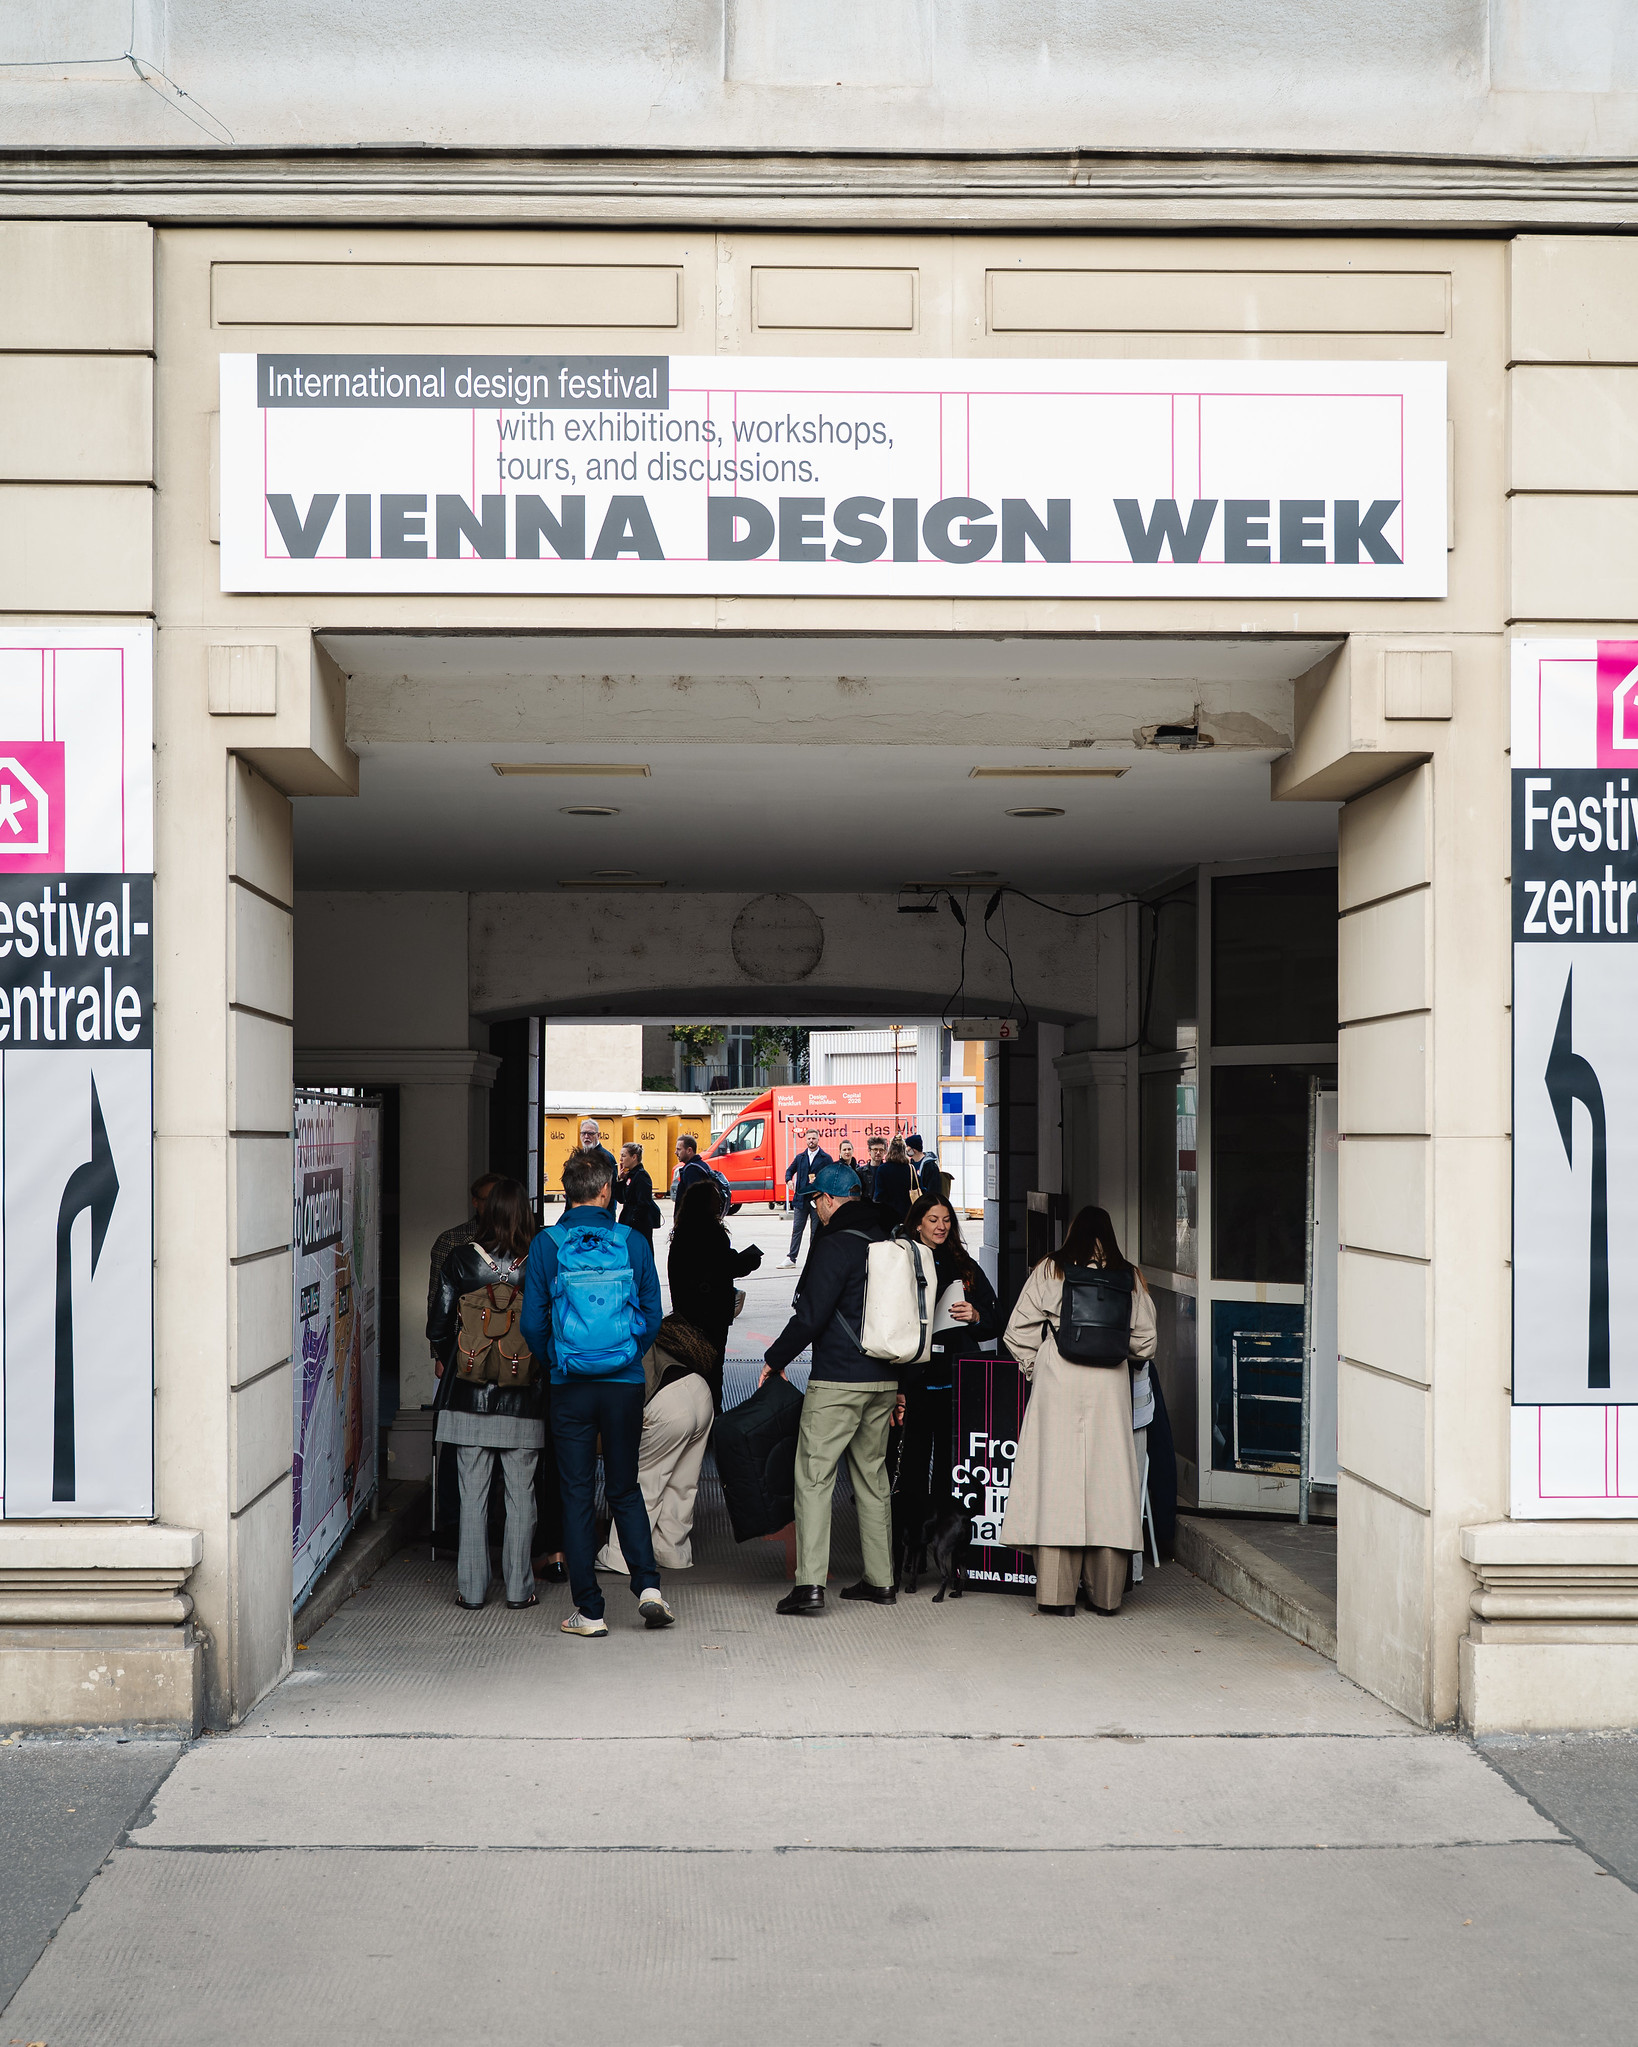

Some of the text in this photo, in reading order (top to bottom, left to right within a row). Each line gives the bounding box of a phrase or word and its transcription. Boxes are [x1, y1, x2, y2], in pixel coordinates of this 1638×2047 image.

[269, 366, 658, 403] International design festival
[497, 408, 894, 451] with exhibitions, workshops,
[497, 452, 820, 486] tours, and discussions.
[265, 493, 1404, 565] VIENNA DESIGN WEEK
[1523, 864, 1638, 935] zentr
[777, 1099, 801, 1107] Frankfurt
[808, 1093, 827, 1101] Design
[842, 1092, 862, 1100] Capital
[778, 1109, 837, 1125] Looking
[864, 1122, 890, 1136] das
[952, 1458, 1015, 1487] dou
[1004, 1572, 1037, 1585] DESIG
